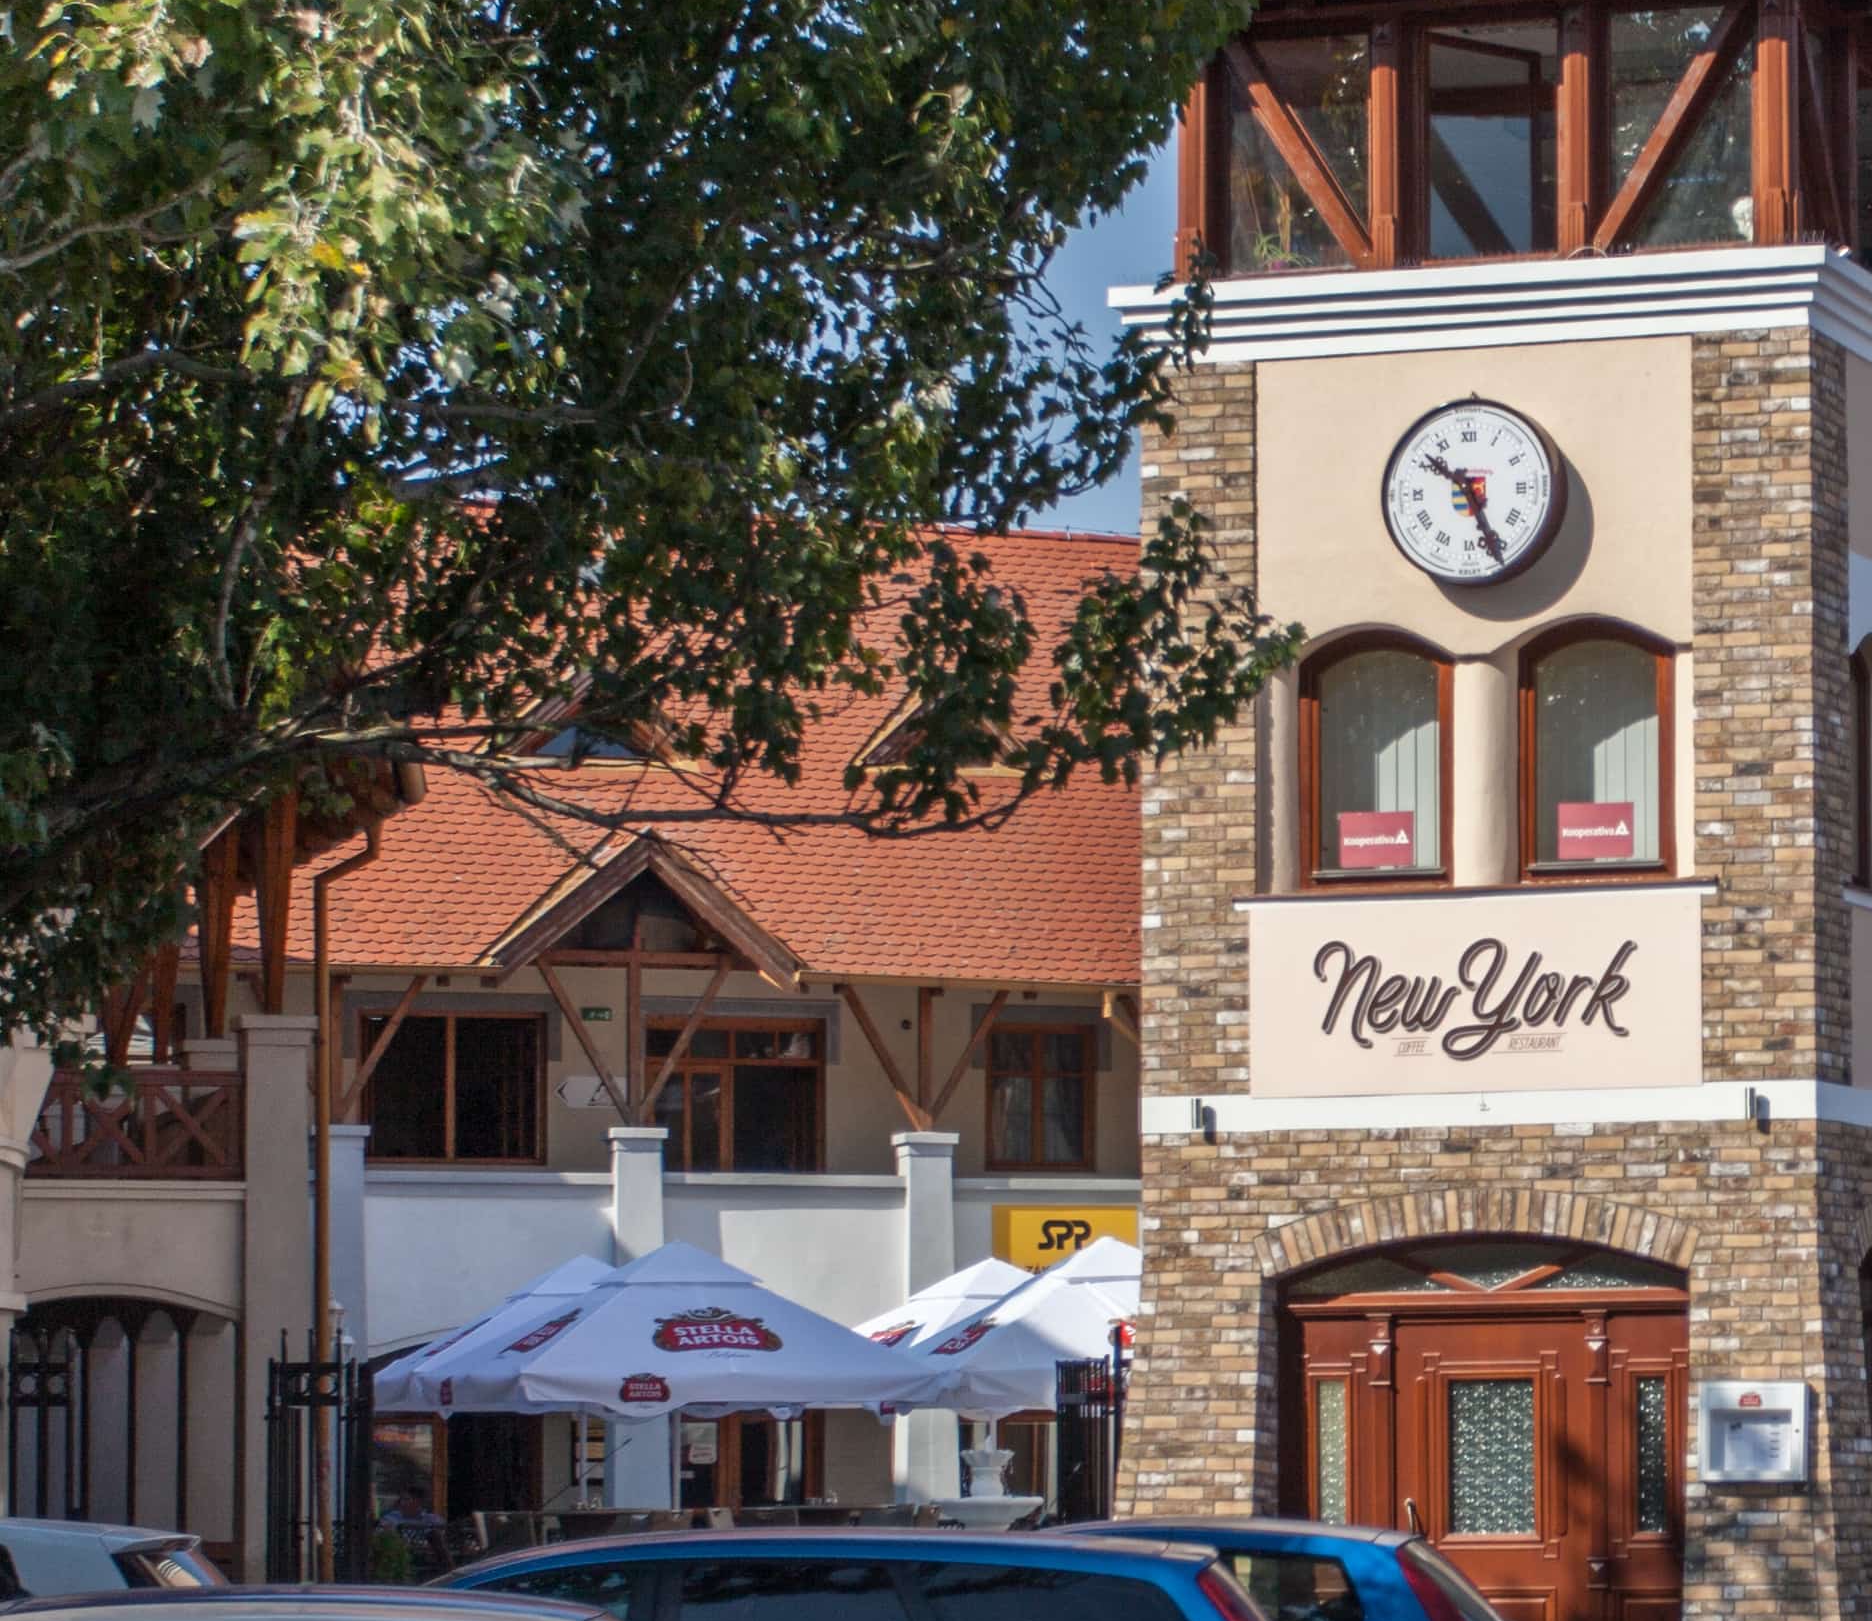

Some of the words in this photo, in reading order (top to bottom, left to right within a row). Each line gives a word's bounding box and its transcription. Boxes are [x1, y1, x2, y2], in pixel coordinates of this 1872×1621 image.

[1461, 431, 1477, 443] XII
[1437, 439, 1450, 453] XI
[1516, 482, 1527, 495] III
[1413, 489, 1424, 502] IX
[1436, 530, 1451, 546] VII
[1562, 826, 1615, 839] Kooperativa
[1343, 835, 1395, 848] Kooperativa
[1314, 940, 1462, 1049] New
[1442, 938, 1638, 1061] York
[1398, 1041, 1426, 1054] COFFEE
[1507, 1036, 1561, 1051] RESTAURANT
[1037, 1219, 1092, 1250] SPP
[673, 1324, 754, 1337] STELLA
[678, 1334, 761, 1346] ARTOIS
[628, 1382, 661, 1390] STELLA
